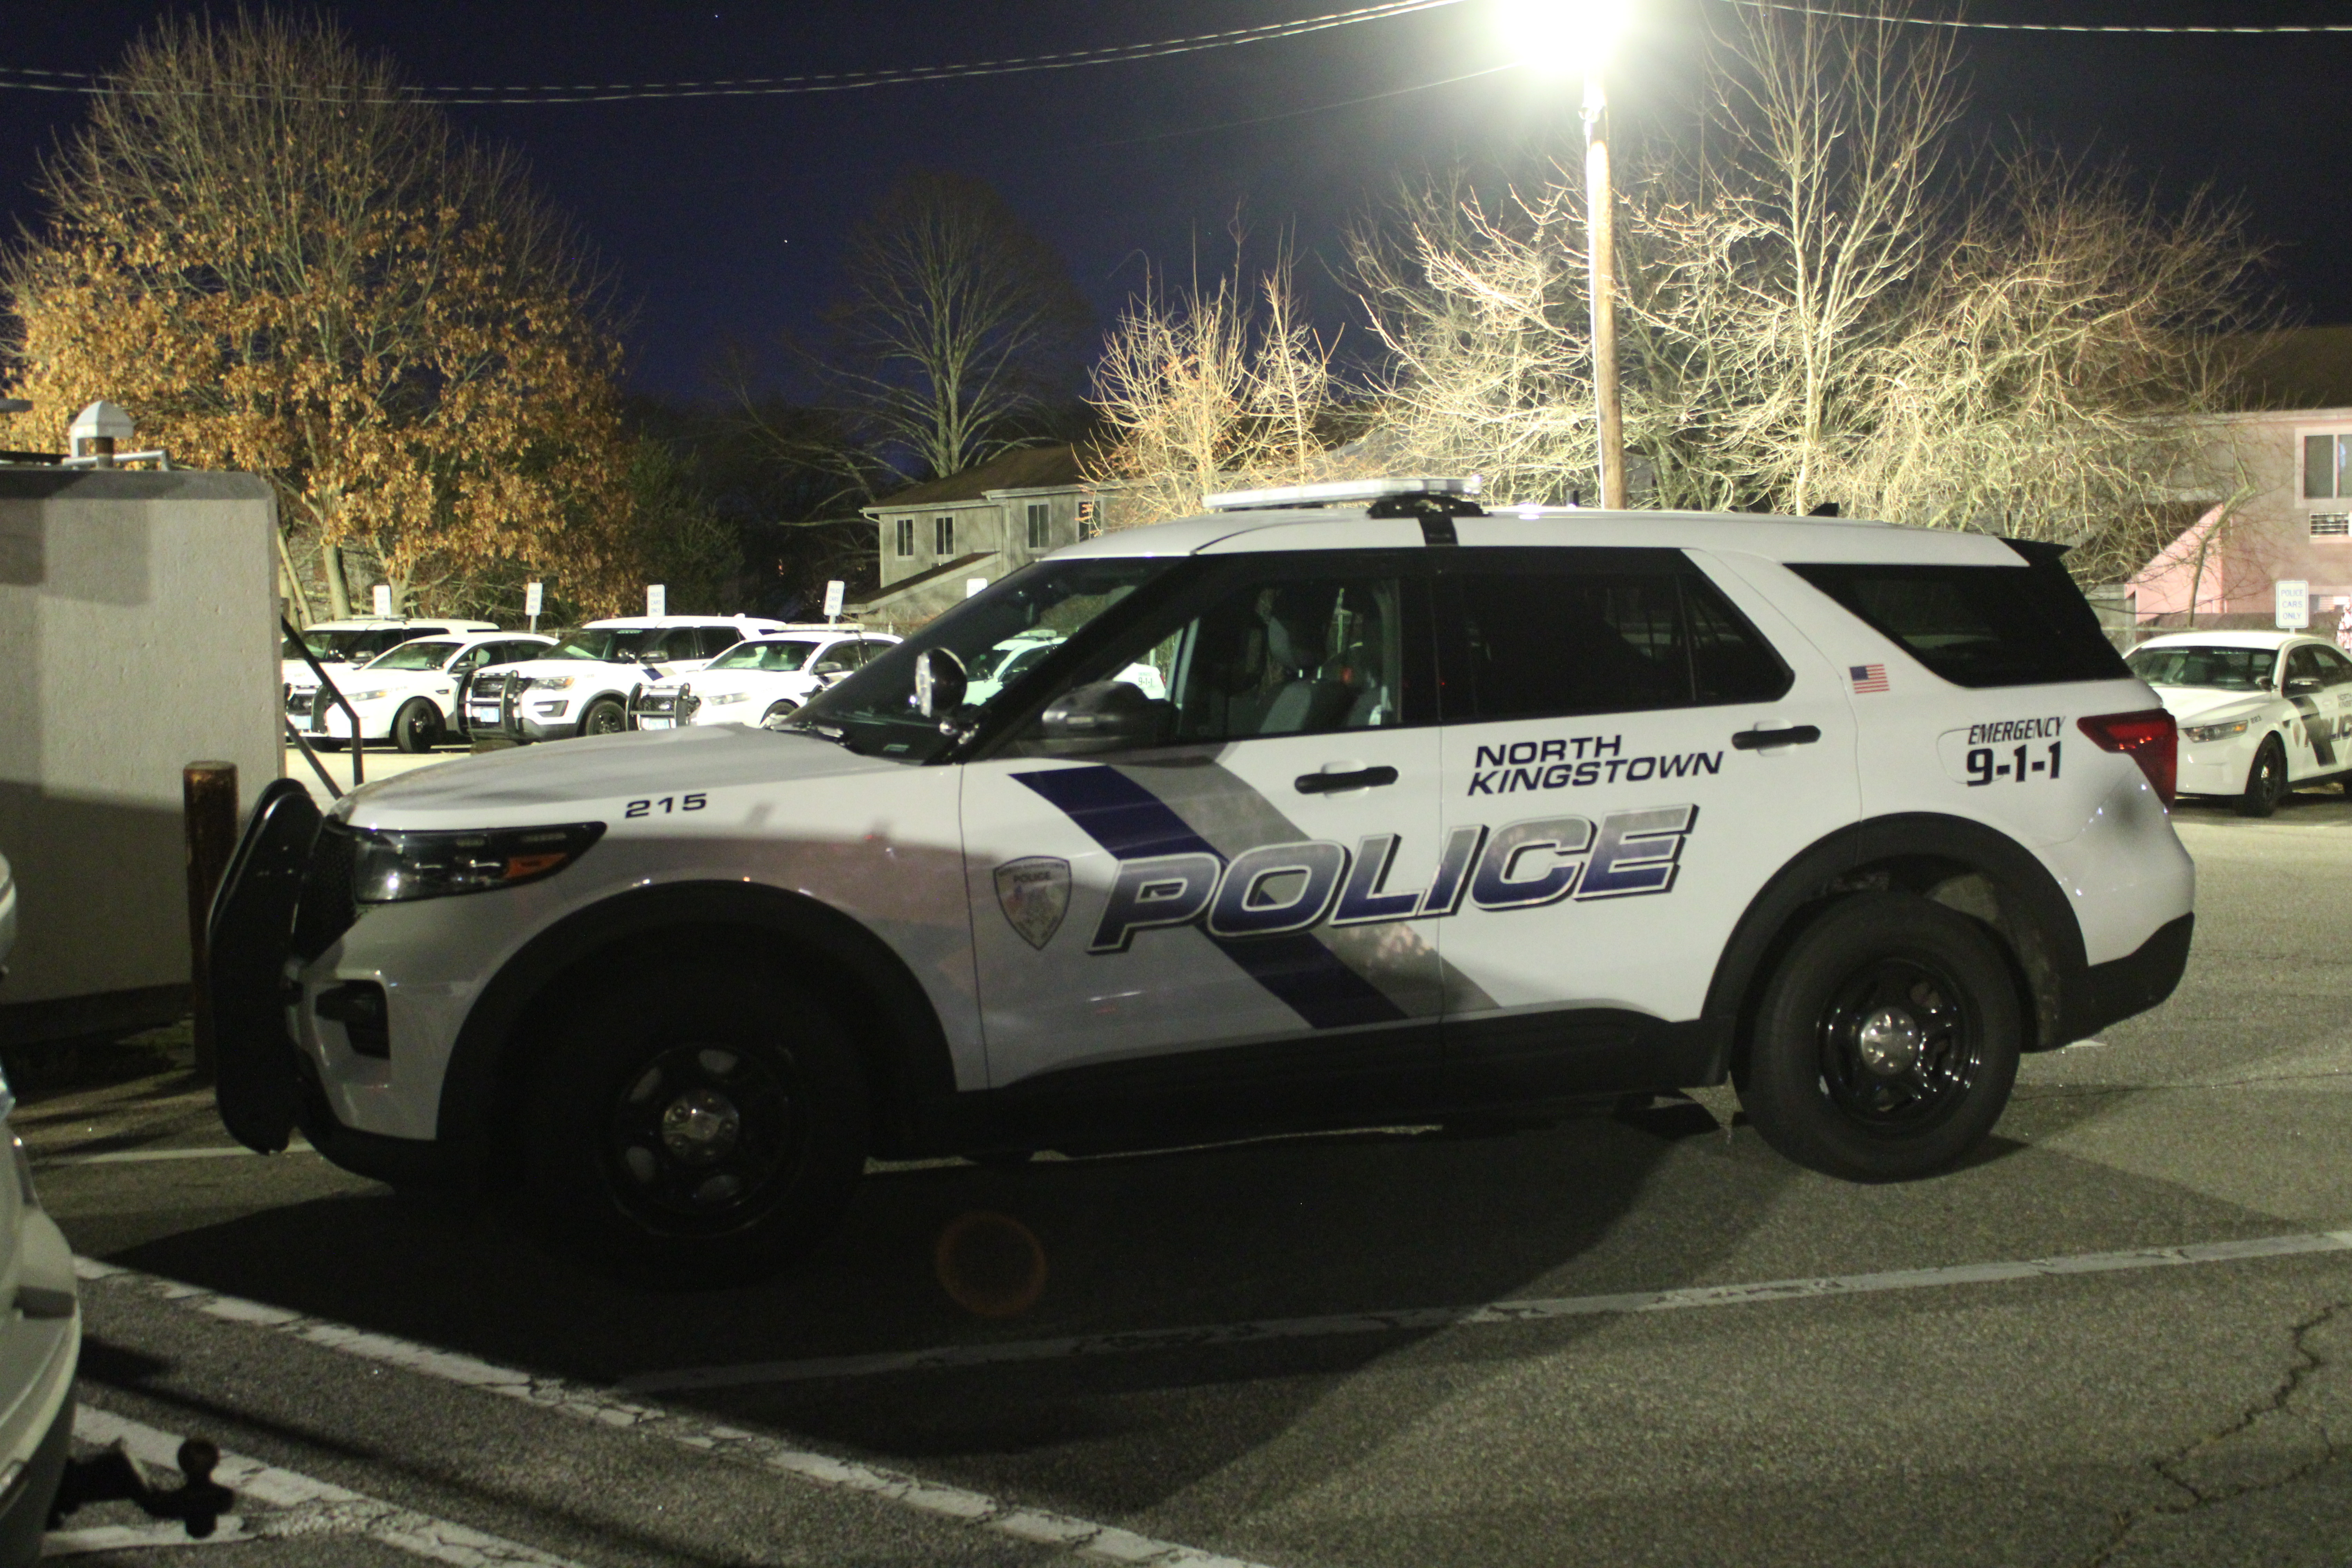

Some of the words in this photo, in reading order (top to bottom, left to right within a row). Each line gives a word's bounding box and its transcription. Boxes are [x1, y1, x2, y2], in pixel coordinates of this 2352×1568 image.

[1967, 716, 2066, 745] EMERGENCY
[1475, 734, 1622, 768] NORTH
[1967, 740, 2062, 787] 9-1-1
[1467, 751, 1724, 796] KINGSTOWN
[624, 793, 708, 819] 215
[1086, 803, 1700, 954] POLICE
